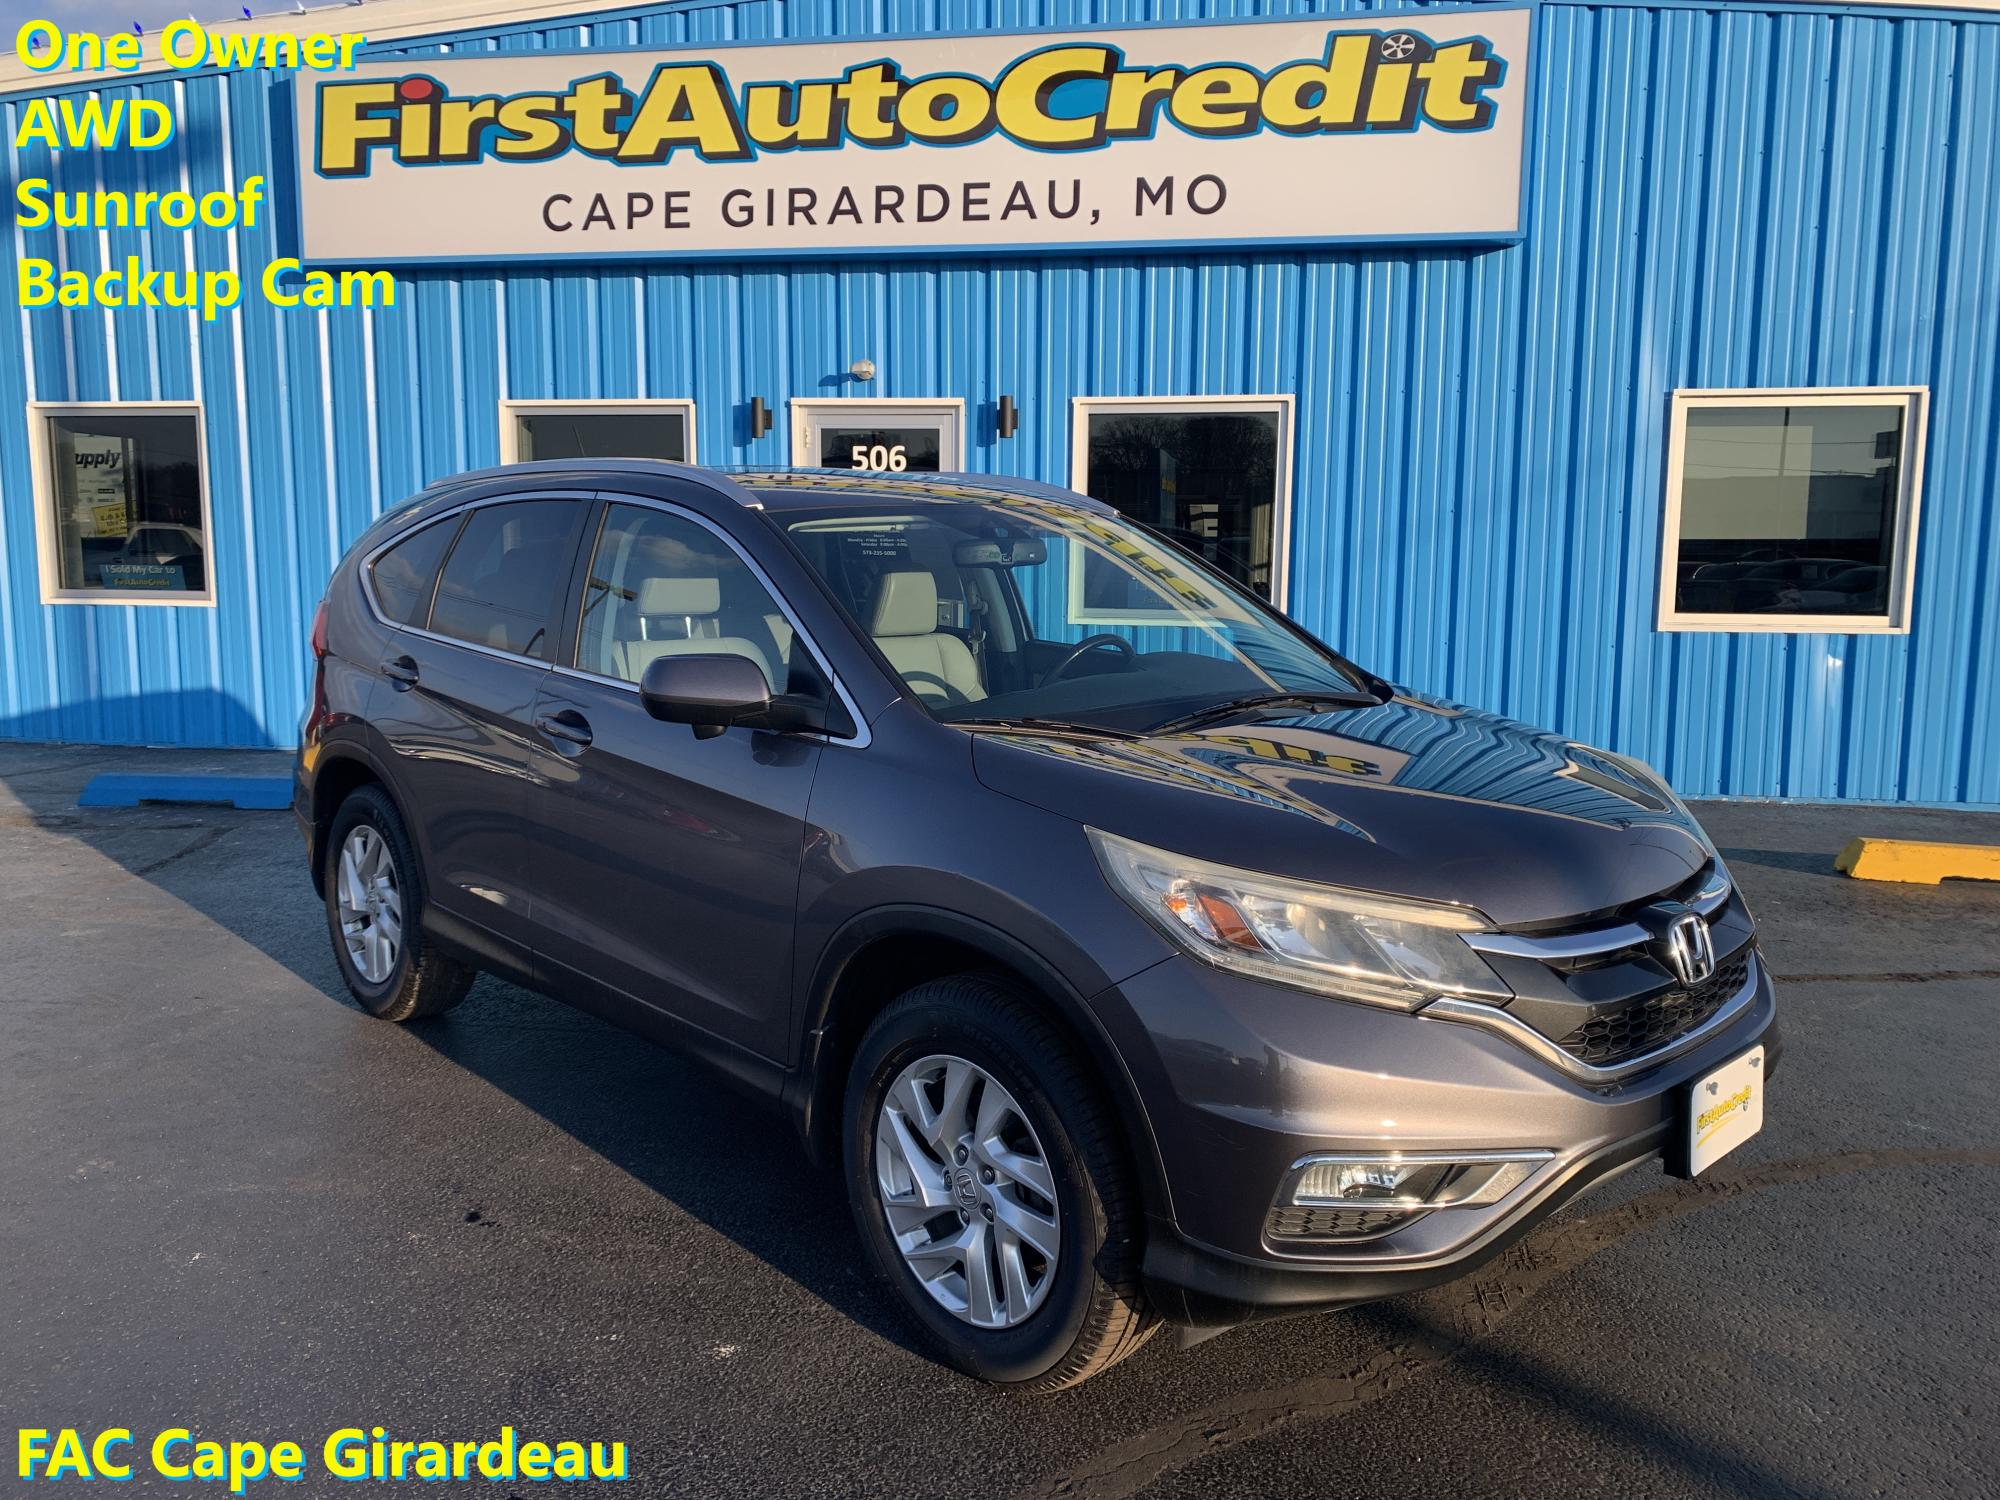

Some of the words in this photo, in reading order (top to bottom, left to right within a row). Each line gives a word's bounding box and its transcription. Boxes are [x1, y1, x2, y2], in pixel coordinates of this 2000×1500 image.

[315, 31, 1505, 177] FirstAutoCredit
[544, 192, 690, 231] CAPE
[721, 179, 1100, 227] GIRARDEAU,
[1135, 174, 1227, 217] MO
[851, 445, 907, 472] 506
[111, 565, 131, 574] Sold
[132, 565, 146, 575] My
[148, 565, 163, 574] Car
[165, 566, 176, 574] to
